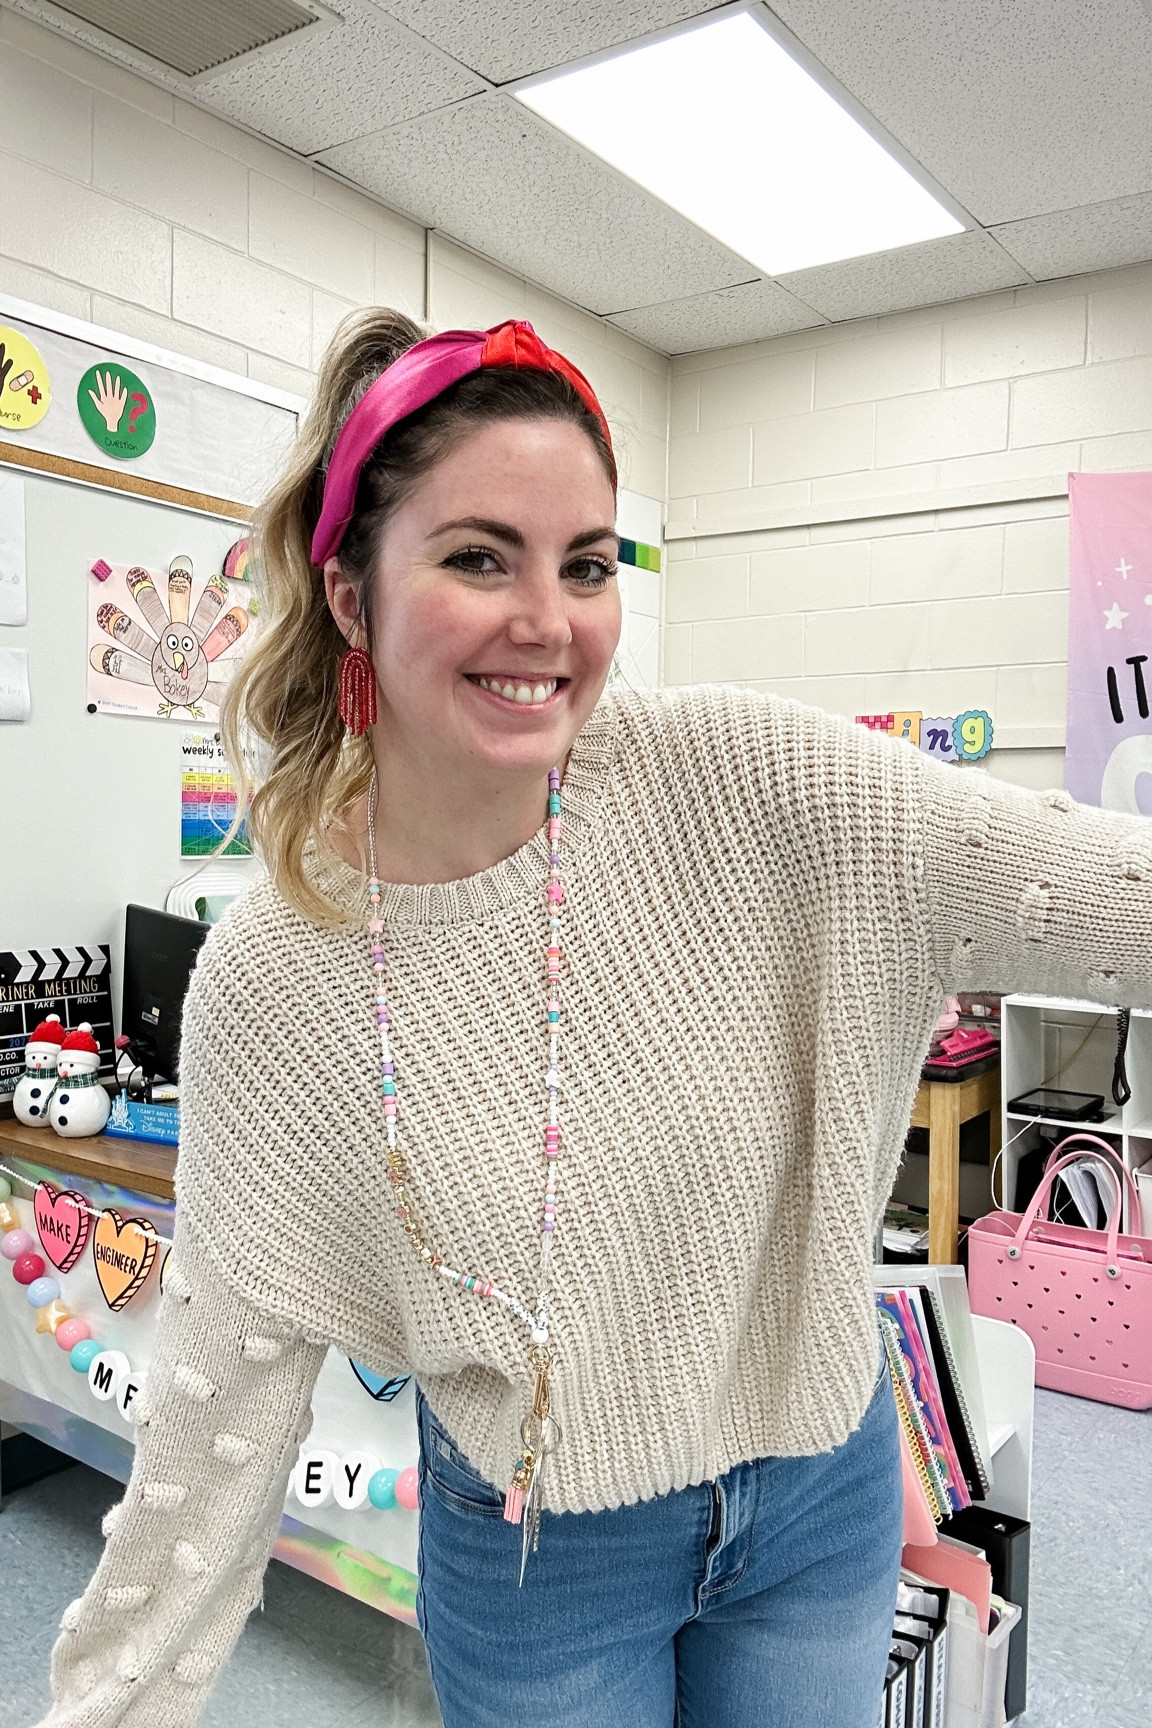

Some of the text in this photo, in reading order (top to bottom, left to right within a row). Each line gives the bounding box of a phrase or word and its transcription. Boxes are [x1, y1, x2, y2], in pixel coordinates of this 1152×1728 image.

[104, 437, 138, 451] Question
[1106, 655, 1149, 724] IT
[182, 746, 214, 759] weekly
[44, 978, 98, 997] MEETING
[34, 1001, 55, 1009] TAKE
[77, 996, 98, 1004] ROLL
[38, 1211, 71, 1245] MAKE
[96, 1242, 138, 1276] ENGINEER
